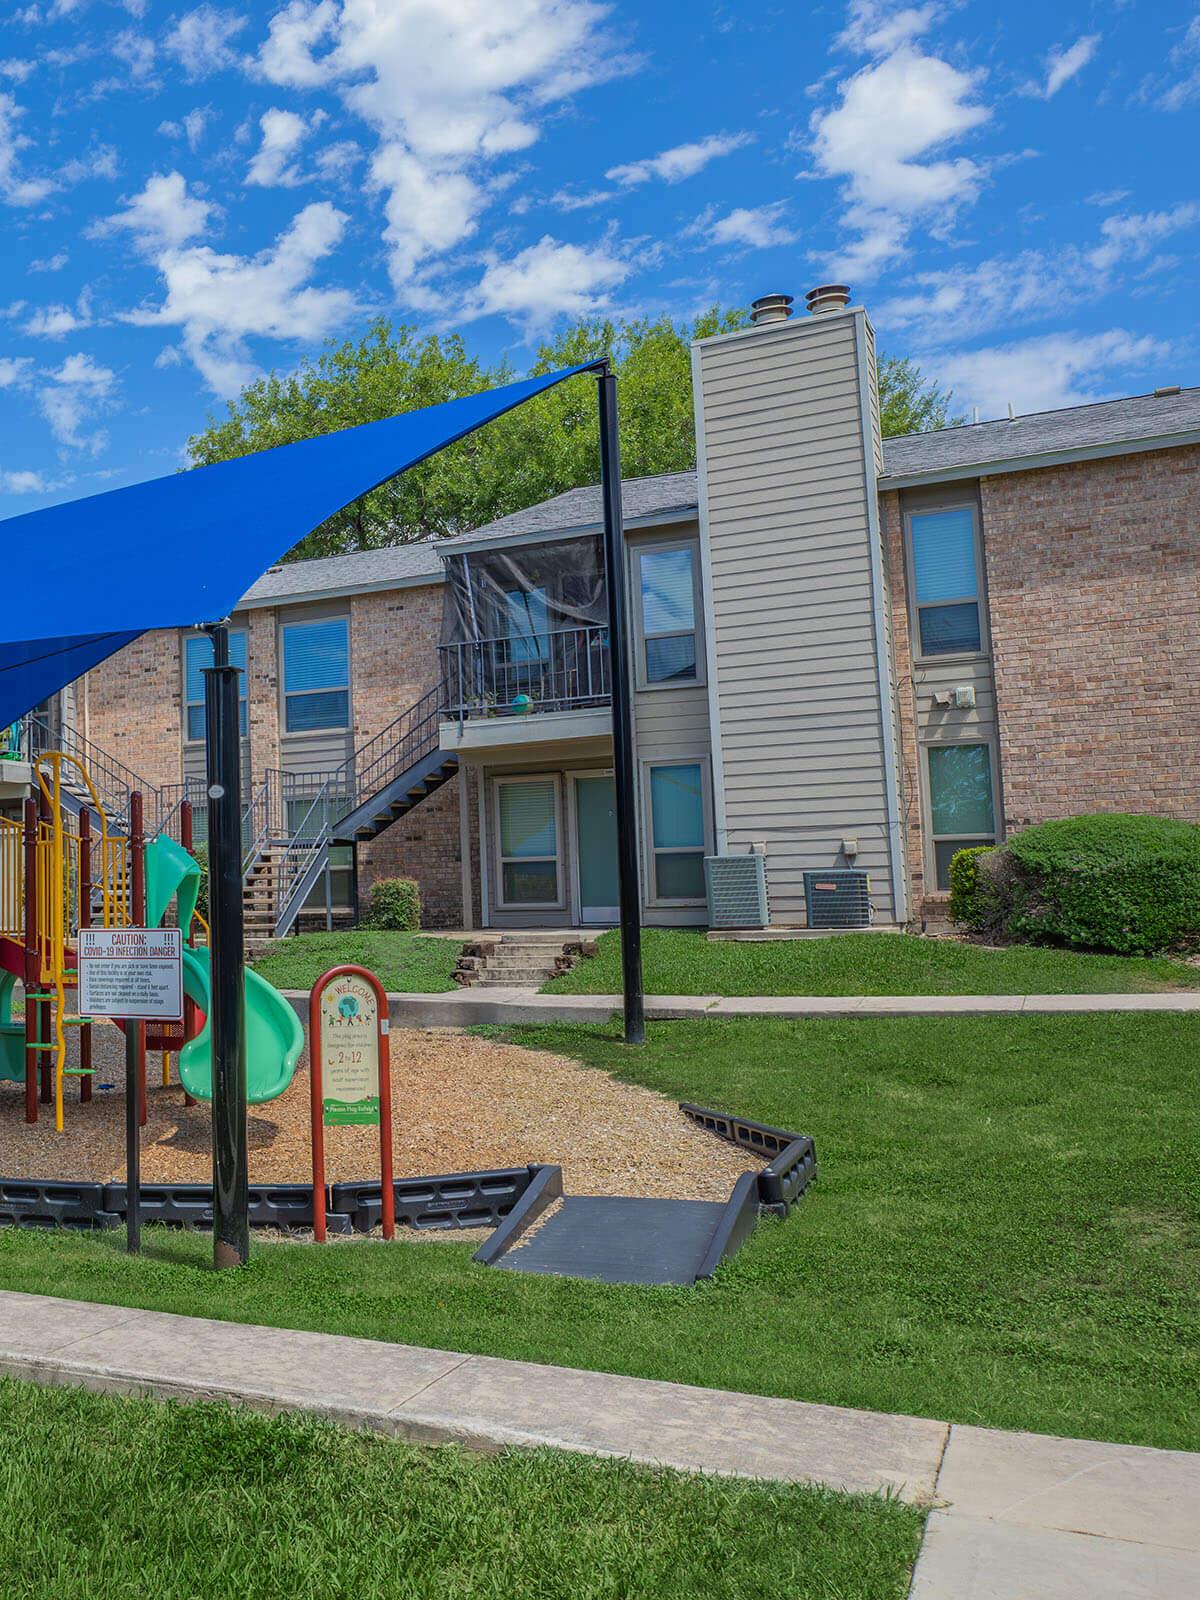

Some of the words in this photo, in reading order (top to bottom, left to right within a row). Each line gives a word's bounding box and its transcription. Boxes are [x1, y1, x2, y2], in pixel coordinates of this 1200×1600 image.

[86, 933, 95, 946] !!!
[112, 934, 146, 946] CAUTION:
[164, 933, 174, 946] !!!
[84, 946, 114, 956] COVID-19
[116, 946, 148, 956] INFECTION
[150, 946, 175, 956] DANGER
[334, 984, 375, 1005] WELCOME
[339, 1051, 344, 1063] 2
[352, 1051, 362, 1063] 12
